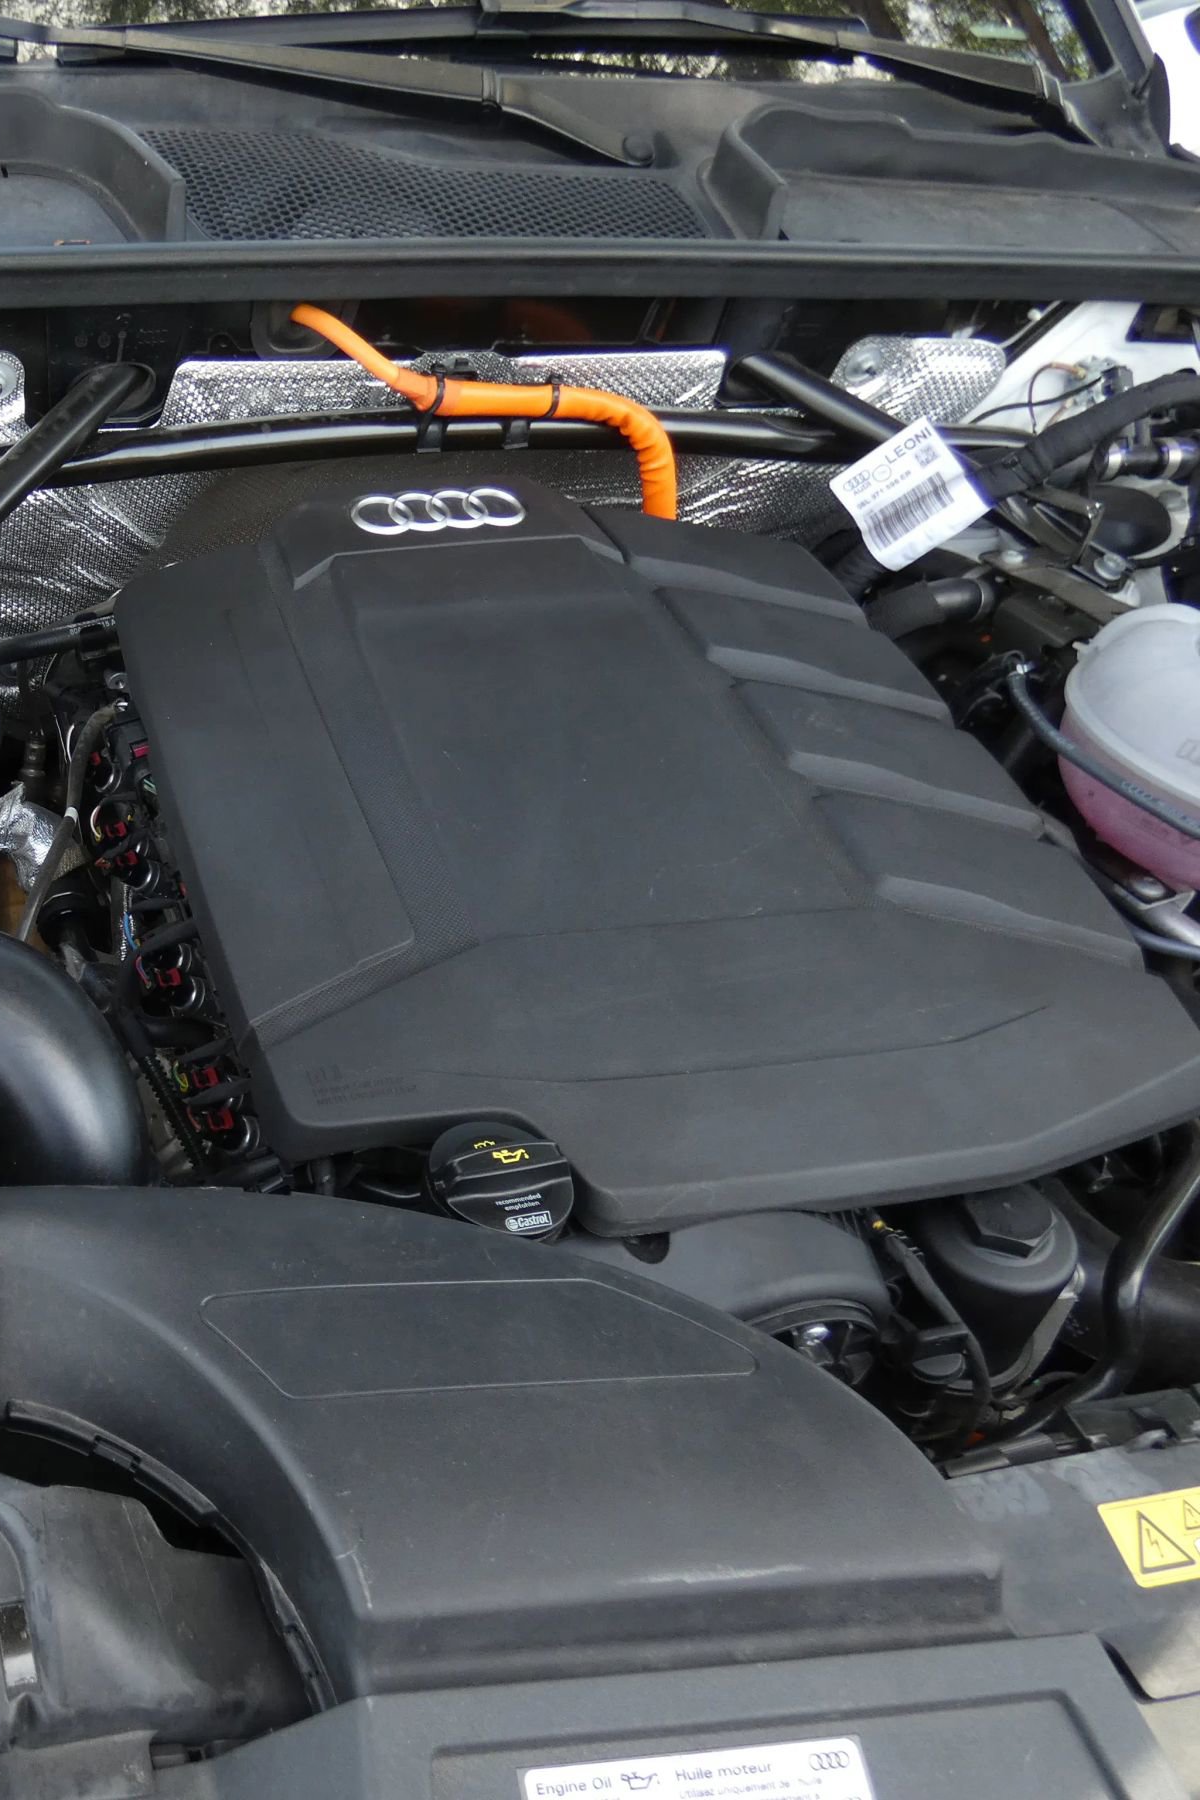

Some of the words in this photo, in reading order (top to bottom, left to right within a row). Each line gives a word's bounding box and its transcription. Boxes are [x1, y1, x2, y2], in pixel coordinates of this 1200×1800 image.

[884, 427, 932, 464] LEONI
[495, 1193, 542, 1206] recommended
[517, 1213, 549, 1228] Castrol
[675, 1767, 713, 1782] Huile
[717, 1763, 773, 1777] moteur
[535, 1782, 587, 1797] Engine
[592, 1776, 612, 1790] Oil
